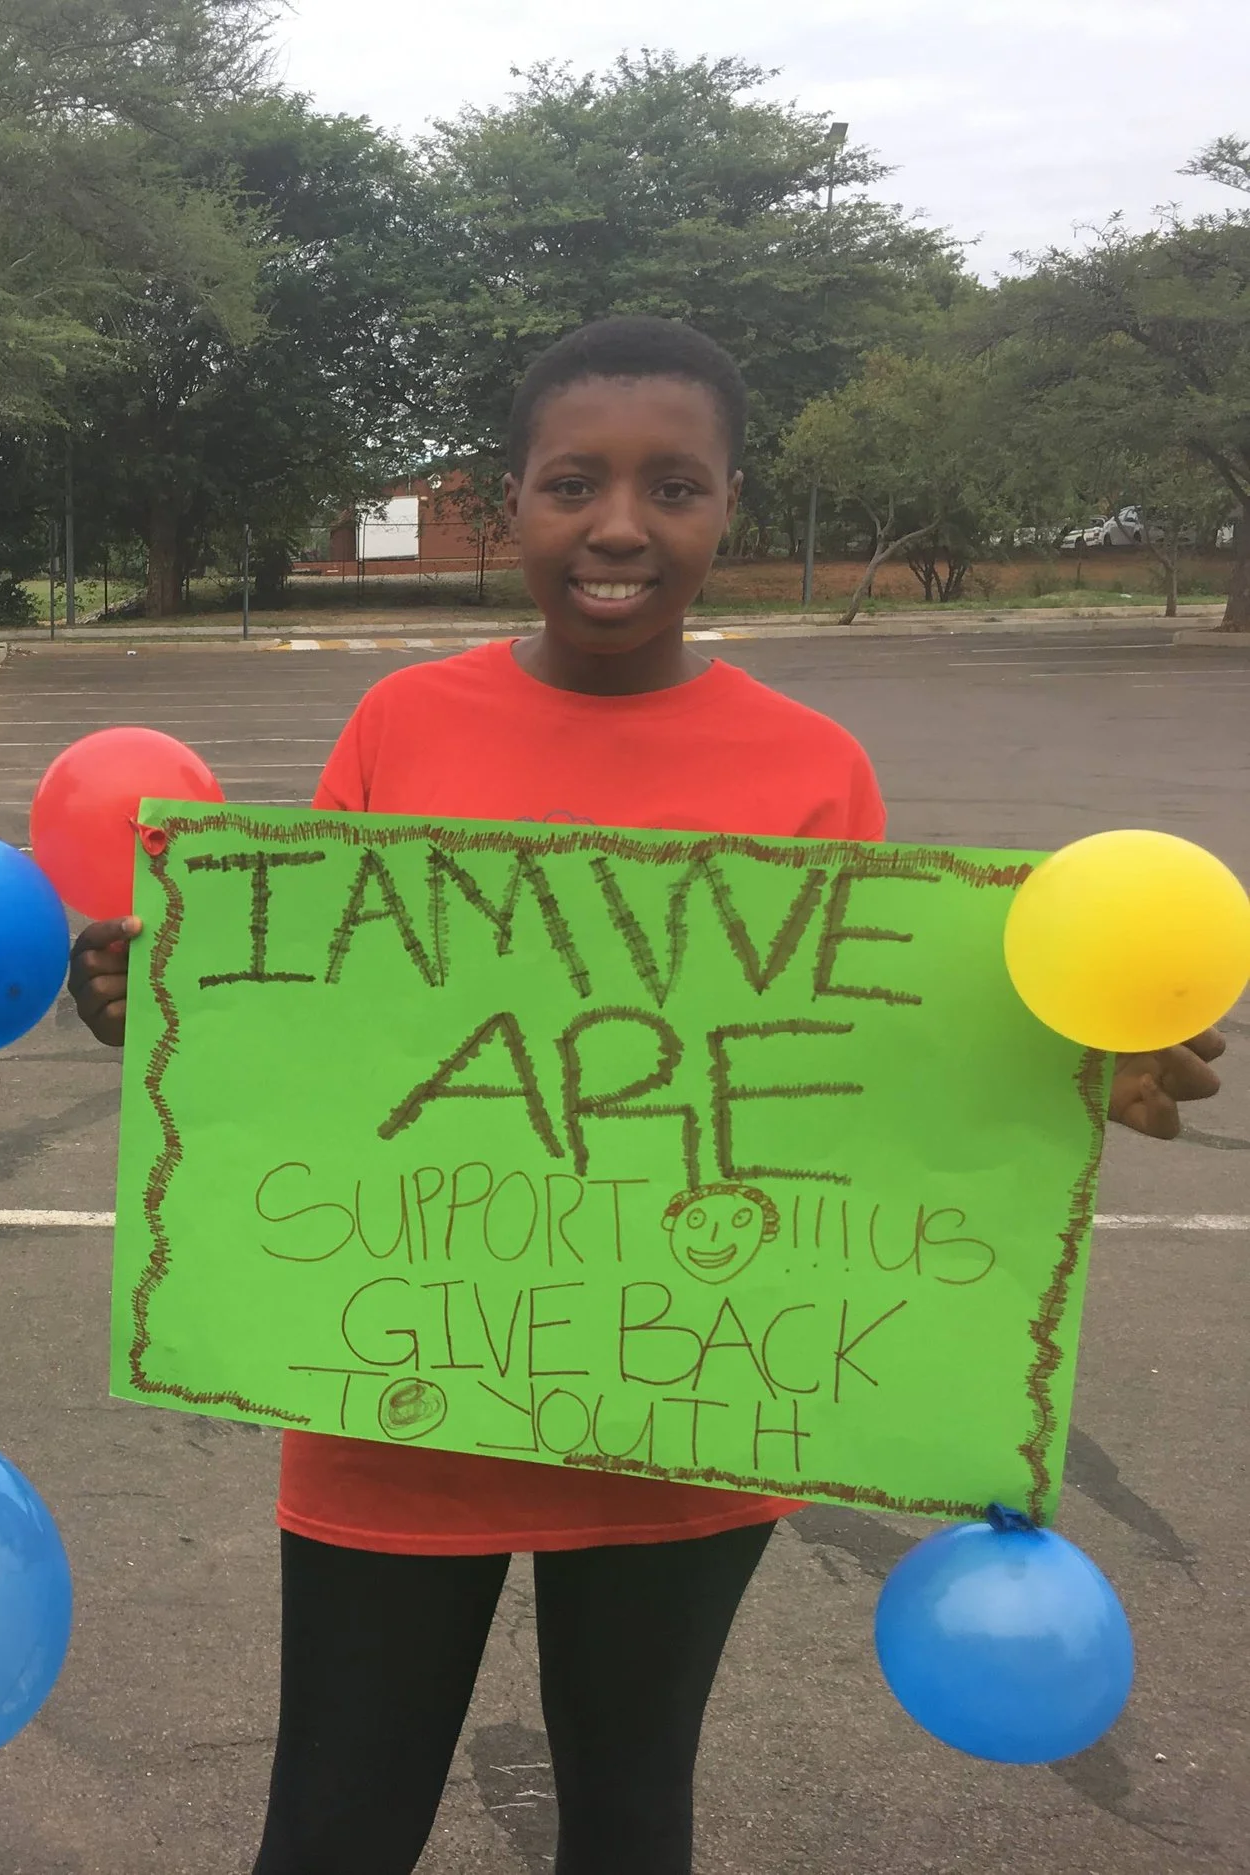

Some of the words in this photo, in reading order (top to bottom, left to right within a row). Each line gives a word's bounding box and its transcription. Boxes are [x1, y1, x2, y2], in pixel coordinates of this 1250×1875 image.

[376, 1005, 864, 1191] ARE
[255, 1161, 650, 1267] SUPPORT
[341, 1277, 591, 1379] GIVE
[618, 1281, 908, 1404] BACK
[475, 1380, 811, 1473] YOUTH
